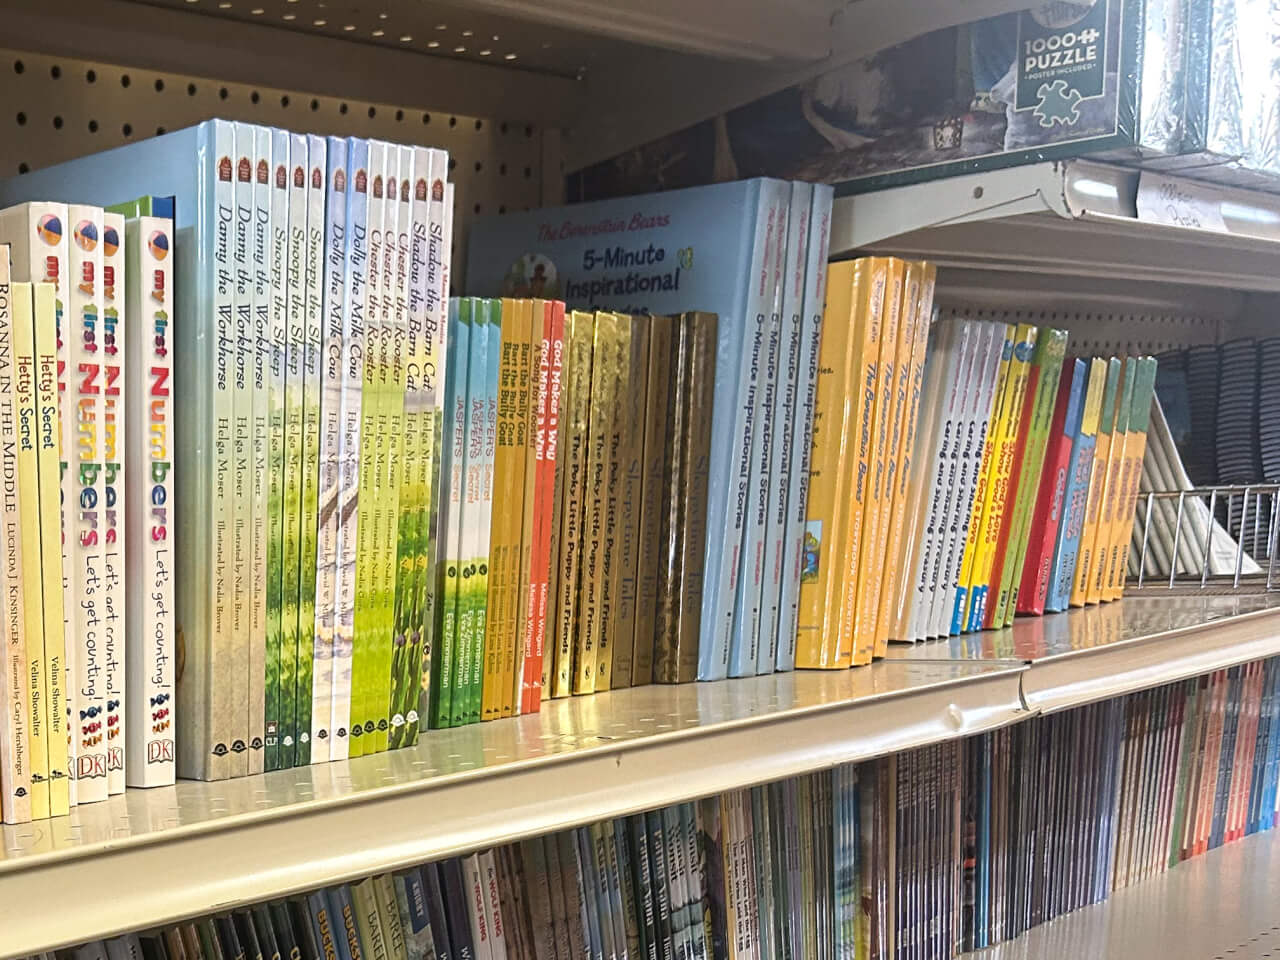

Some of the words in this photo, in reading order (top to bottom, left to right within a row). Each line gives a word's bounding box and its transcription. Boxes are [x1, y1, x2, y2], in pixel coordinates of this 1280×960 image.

[1025, 46, 1097, 73] PUZZLE
[216, 204, 233, 264] Danny
[427, 222, 441, 284] Shadow
[288, 227, 304, 290] Snoopy
[583, 244, 666, 271] 5-Minute
[152, 270, 165, 303] my
[218, 267, 230, 295] the
[426, 287, 439, 312] the
[565, 267, 680, 300] Inspirational
[291, 292, 302, 320] the
[154, 309, 168, 358] first
[217, 304, 234, 390] Workhorse
[289, 328, 303, 375] Sheep
[425, 319, 438, 357] Barn
[751, 314, 765, 381] 5-Minute
[0, 375, 11, 393] IN
[17, 355, 32, 403] Hetty's
[422, 362, 435, 391] Cat
[1, 399, 12, 435] THE
[20, 408, 33, 451] Secret
[740, 384, 757, 470] Inspirational
[151, 367, 170, 541] Numbers
[2, 441, 17, 513] MIDDLE
[734, 474, 748, 530] Stories
[155, 550, 169, 588] Let's
[152, 593, 168, 616] get
[152, 622, 171, 688] counting!
[149, 741, 172, 761] DK
